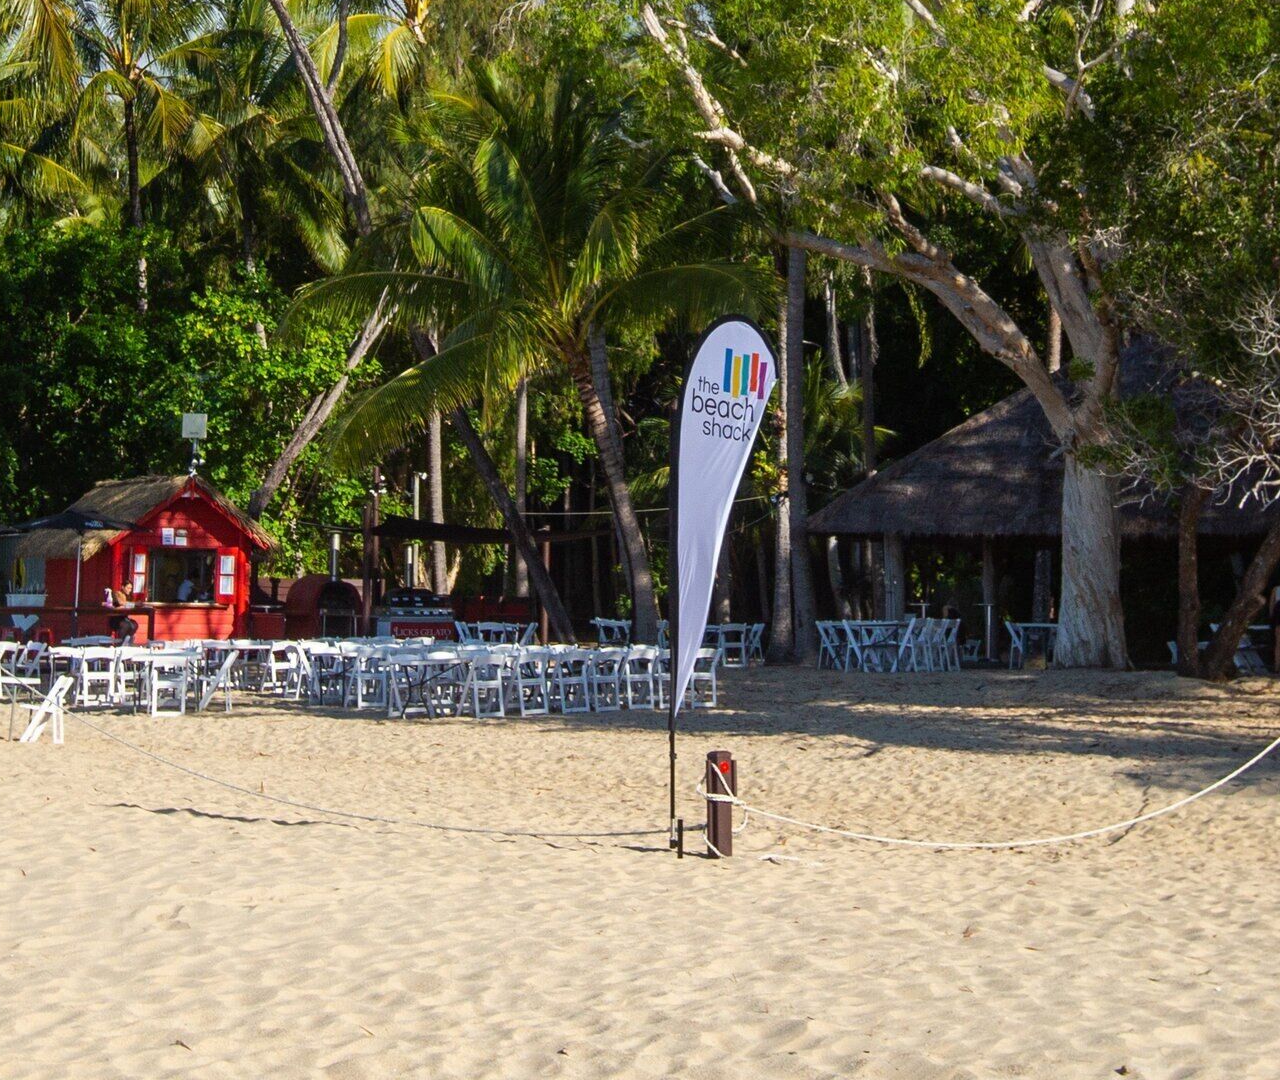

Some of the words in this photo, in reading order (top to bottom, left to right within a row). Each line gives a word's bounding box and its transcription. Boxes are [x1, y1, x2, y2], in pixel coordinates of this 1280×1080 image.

[698, 376, 719, 394] the
[691, 388, 754, 422] beach
[702, 417, 751, 442] shack
